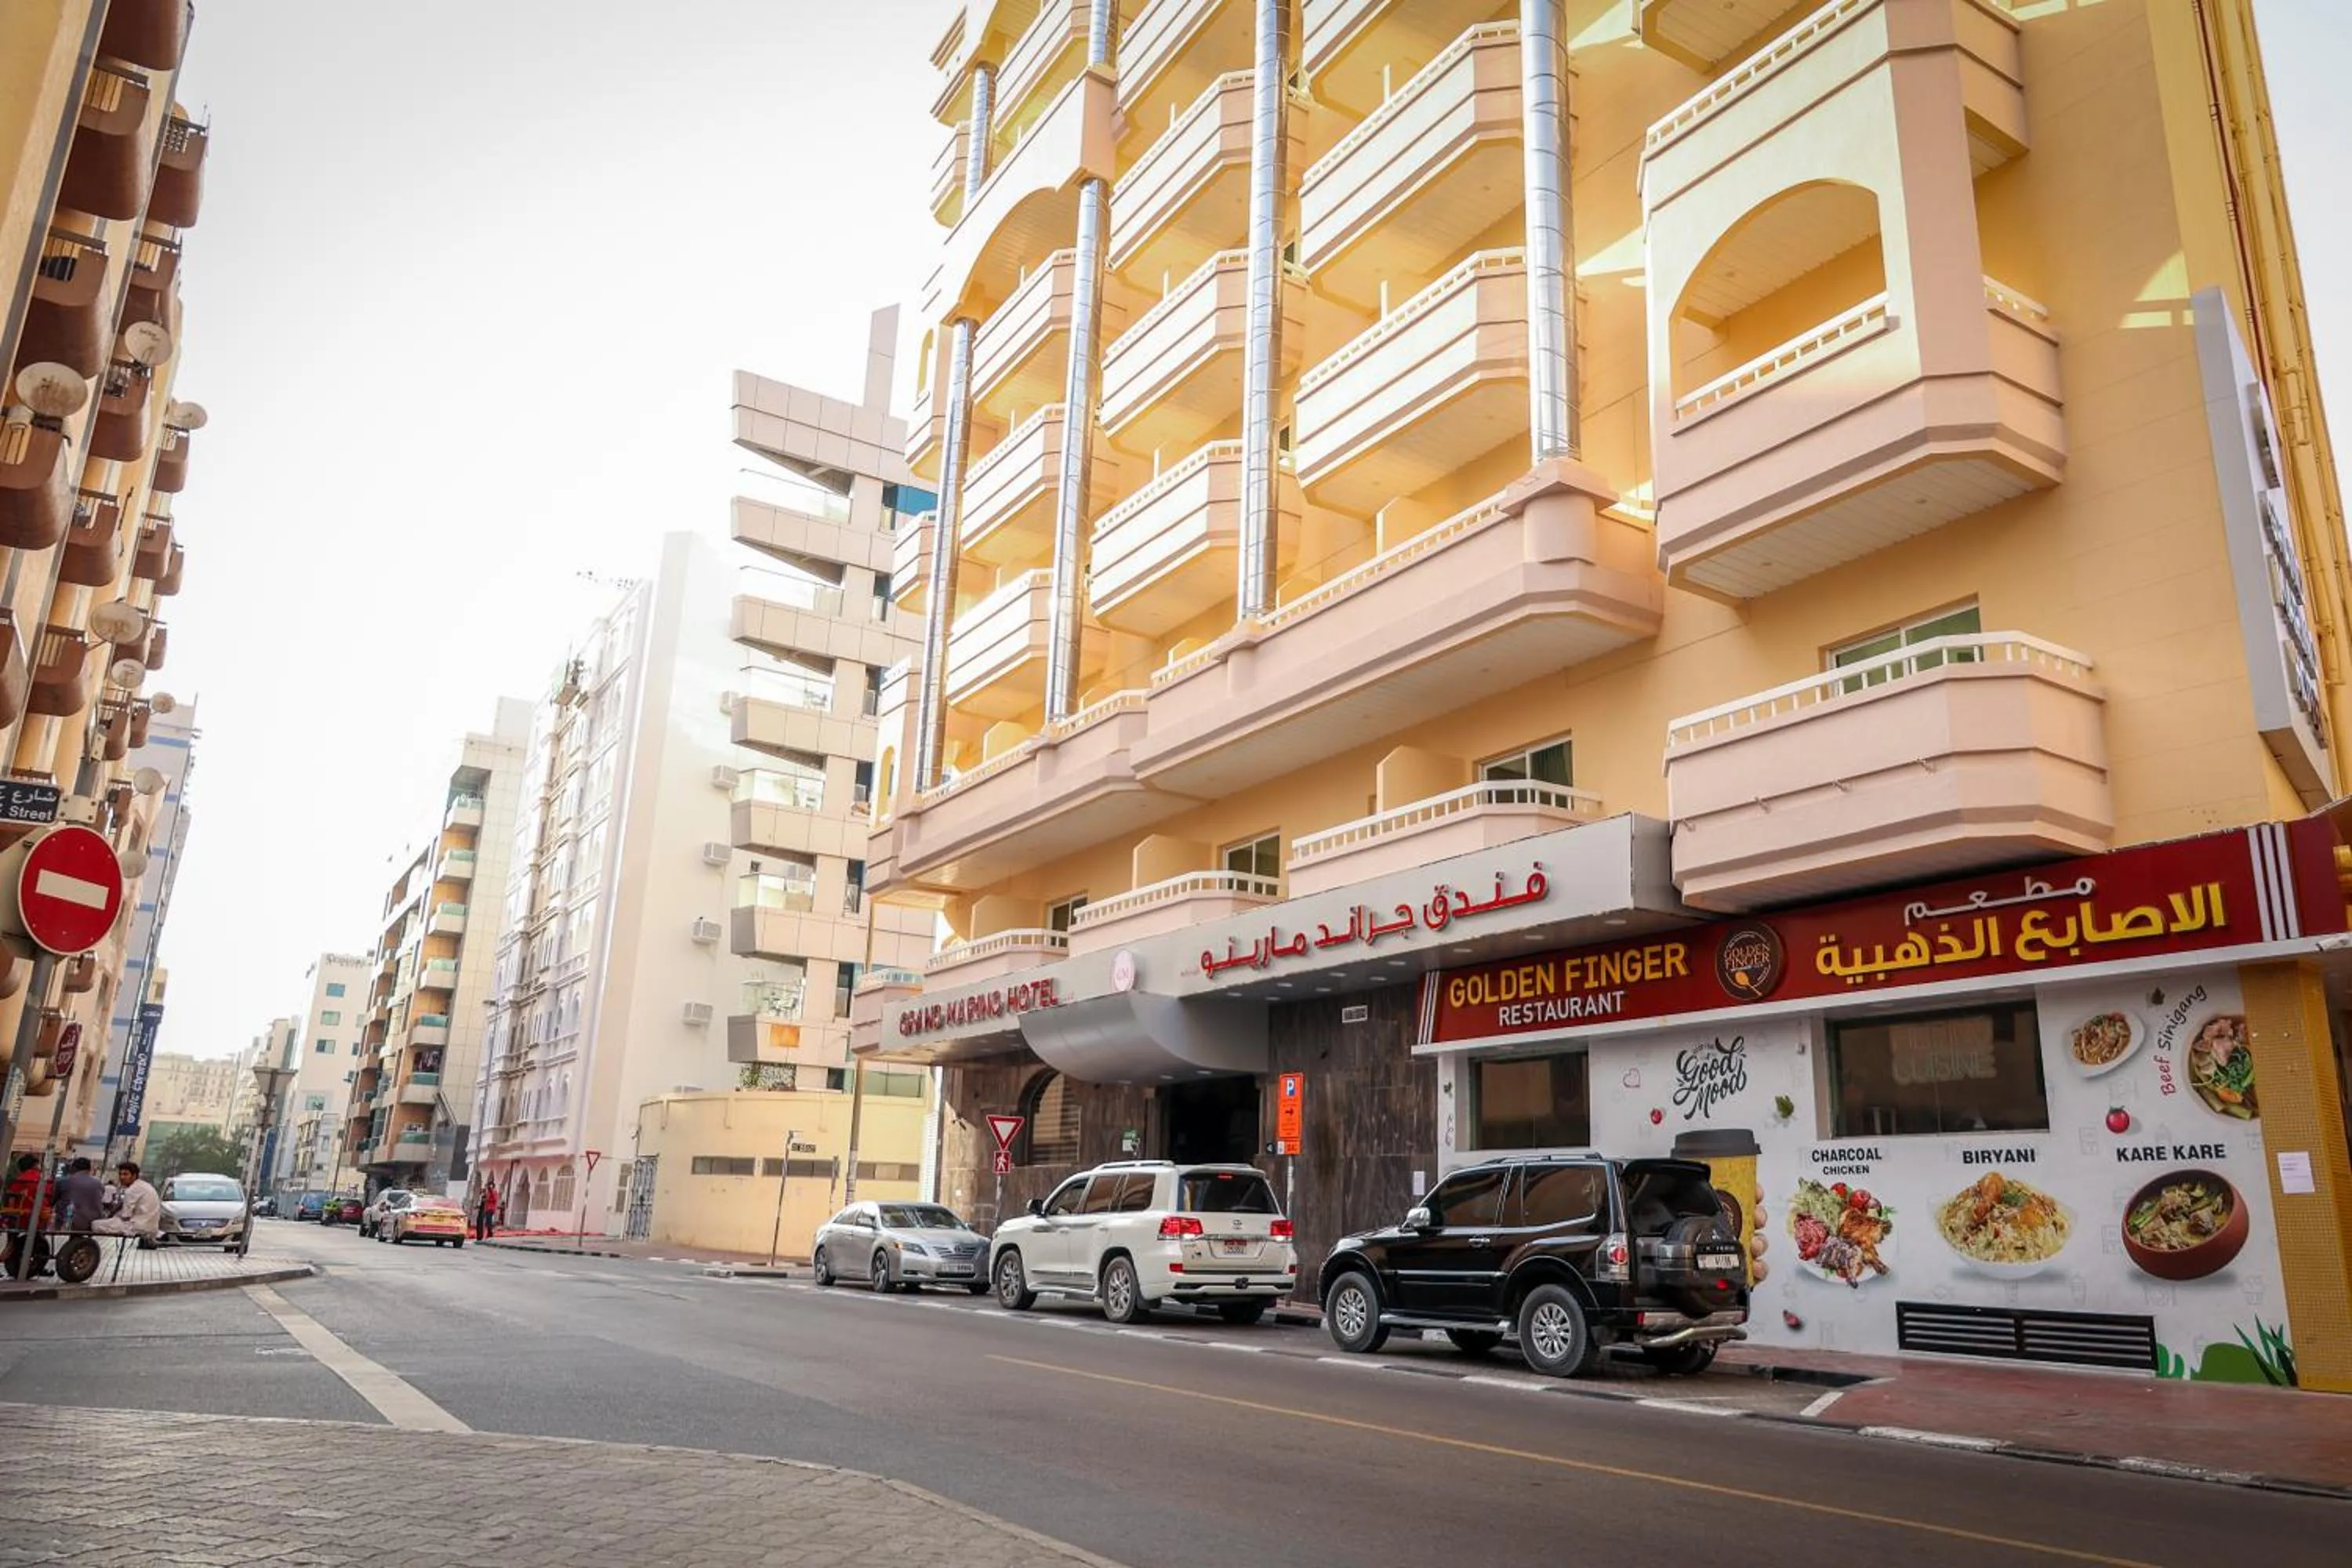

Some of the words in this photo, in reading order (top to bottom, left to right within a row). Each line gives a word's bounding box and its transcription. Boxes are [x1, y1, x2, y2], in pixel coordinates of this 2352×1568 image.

[9, 805, 53, 821] Street
[12, 789, 57, 804] شارع
[1423, 861, 1549, 931] فندق
[1904, 876, 2095, 926] مطعم
[1313, 903, 1414, 947] جراند
[2015, 881, 2227, 961] الاصابع
[1200, 926, 1307, 978] مارينو
[1724, 943, 1770, 960] GOLDEN
[1726, 953, 1770, 970] FINGER
[1816, 916, 2001, 984] الذهبية
[1007, 978, 1058, 1013] HOTEL
[1450, 960, 1555, 1008] GOLDEN
[1565, 942, 1690, 992] FINGER
[1499, 990, 1626, 1027] RESTAURANT
[2158, 985, 2208, 1051] Sinigang
[1673, 1036, 1746, 1105] Good
[1684, 1060, 1747, 1120] Mood
[2154, 1055, 2177, 1096] Beef
[1812, 1148, 1882, 1163] CHARCOAL
[1823, 1165, 1870, 1176] CHICKEN
[1962, 1149, 2037, 1165] BIRYANI
[2117, 1145, 2169, 1163] KARE
[2172, 1144, 2227, 1160] KARE
